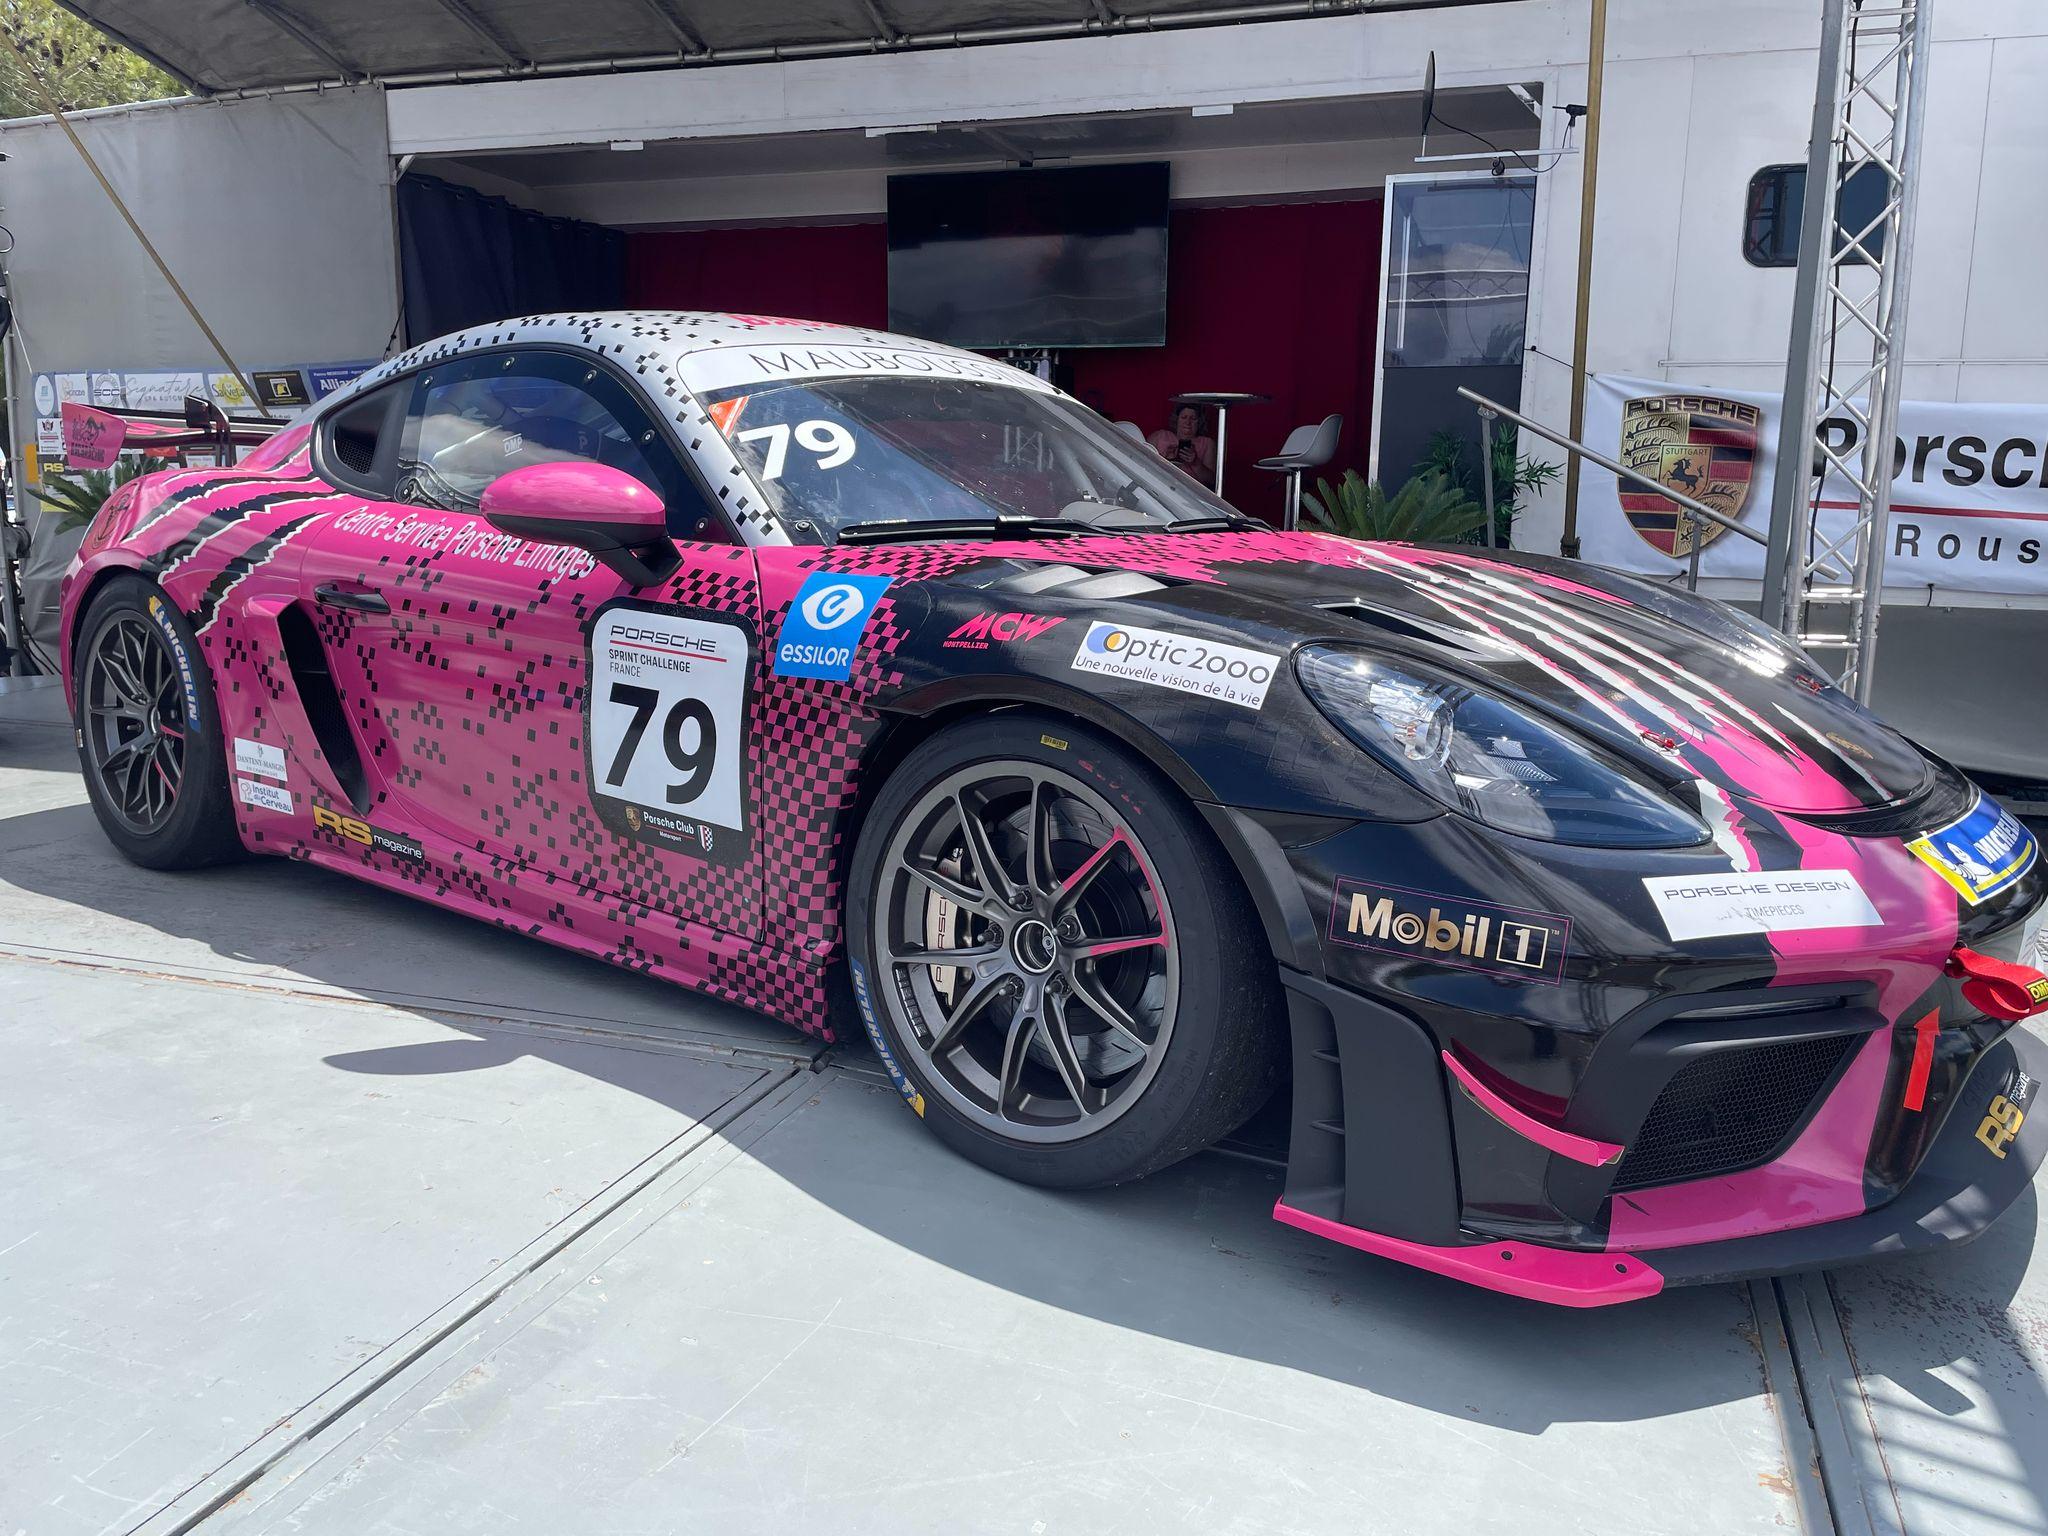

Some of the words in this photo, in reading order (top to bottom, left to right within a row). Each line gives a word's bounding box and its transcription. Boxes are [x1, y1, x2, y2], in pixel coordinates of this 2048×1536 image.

[320, 378, 349, 391] Allia
[1626, 398, 1757, 424] PORSCHE
[504, 436, 523, 453] OMP
[737, 420, 856, 481] 79
[1665, 447, 1708, 456] STUTTGART
[43, 462, 65, 473] RS
[333, 505, 395, 538] Centre
[384, 513, 453, 550] Service
[452, 520, 522, 563] Porsche
[1894, 523, 2041, 564] Rous
[610, 625, 716, 653] PORSCHE
[947, 611, 1067, 642] MCW
[942, 641, 989, 650] MONTPELLIER
[1103, 630, 1187, 665] Optic
[163, 621, 198, 721] MICHELIN
[609, 648, 638, 664] SPRINT
[640, 653, 690, 673] CHALLENGE
[609, 661, 641, 678] FRANCE
[1074, 655, 1101, 670] Une
[1102, 663, 1157, 681] nouvelle
[1161, 673, 1199, 691] vision
[1203, 682, 1220, 695] de
[1224, 686, 1236, 700] la
[1240, 692, 1260, 706] vie
[605, 681, 717, 805] 79
[252, 783, 280, 799] Institut
[261, 796, 293, 812] Cerveau
[312, 804, 373, 846] RS
[373, 834, 422, 859] magazine
[643, 811, 675, 830] Porsche
[676, 820, 694, 835] Club
[659, 830, 682, 842] Motorsport
[1664, 884, 1771, 900] PORSCHE
[1775, 881, 1851, 893] DESIGN
[1746, 904, 1804, 917] TIMEPIECES
[934, 866, 948, 983] PRSCE
[1347, 892, 1490, 959] Mobil
[854, 968, 901, 1079] MICHELIN
[1974, 1094, 2024, 1160] RS
[2009, 1071, 2030, 1106] magazine
